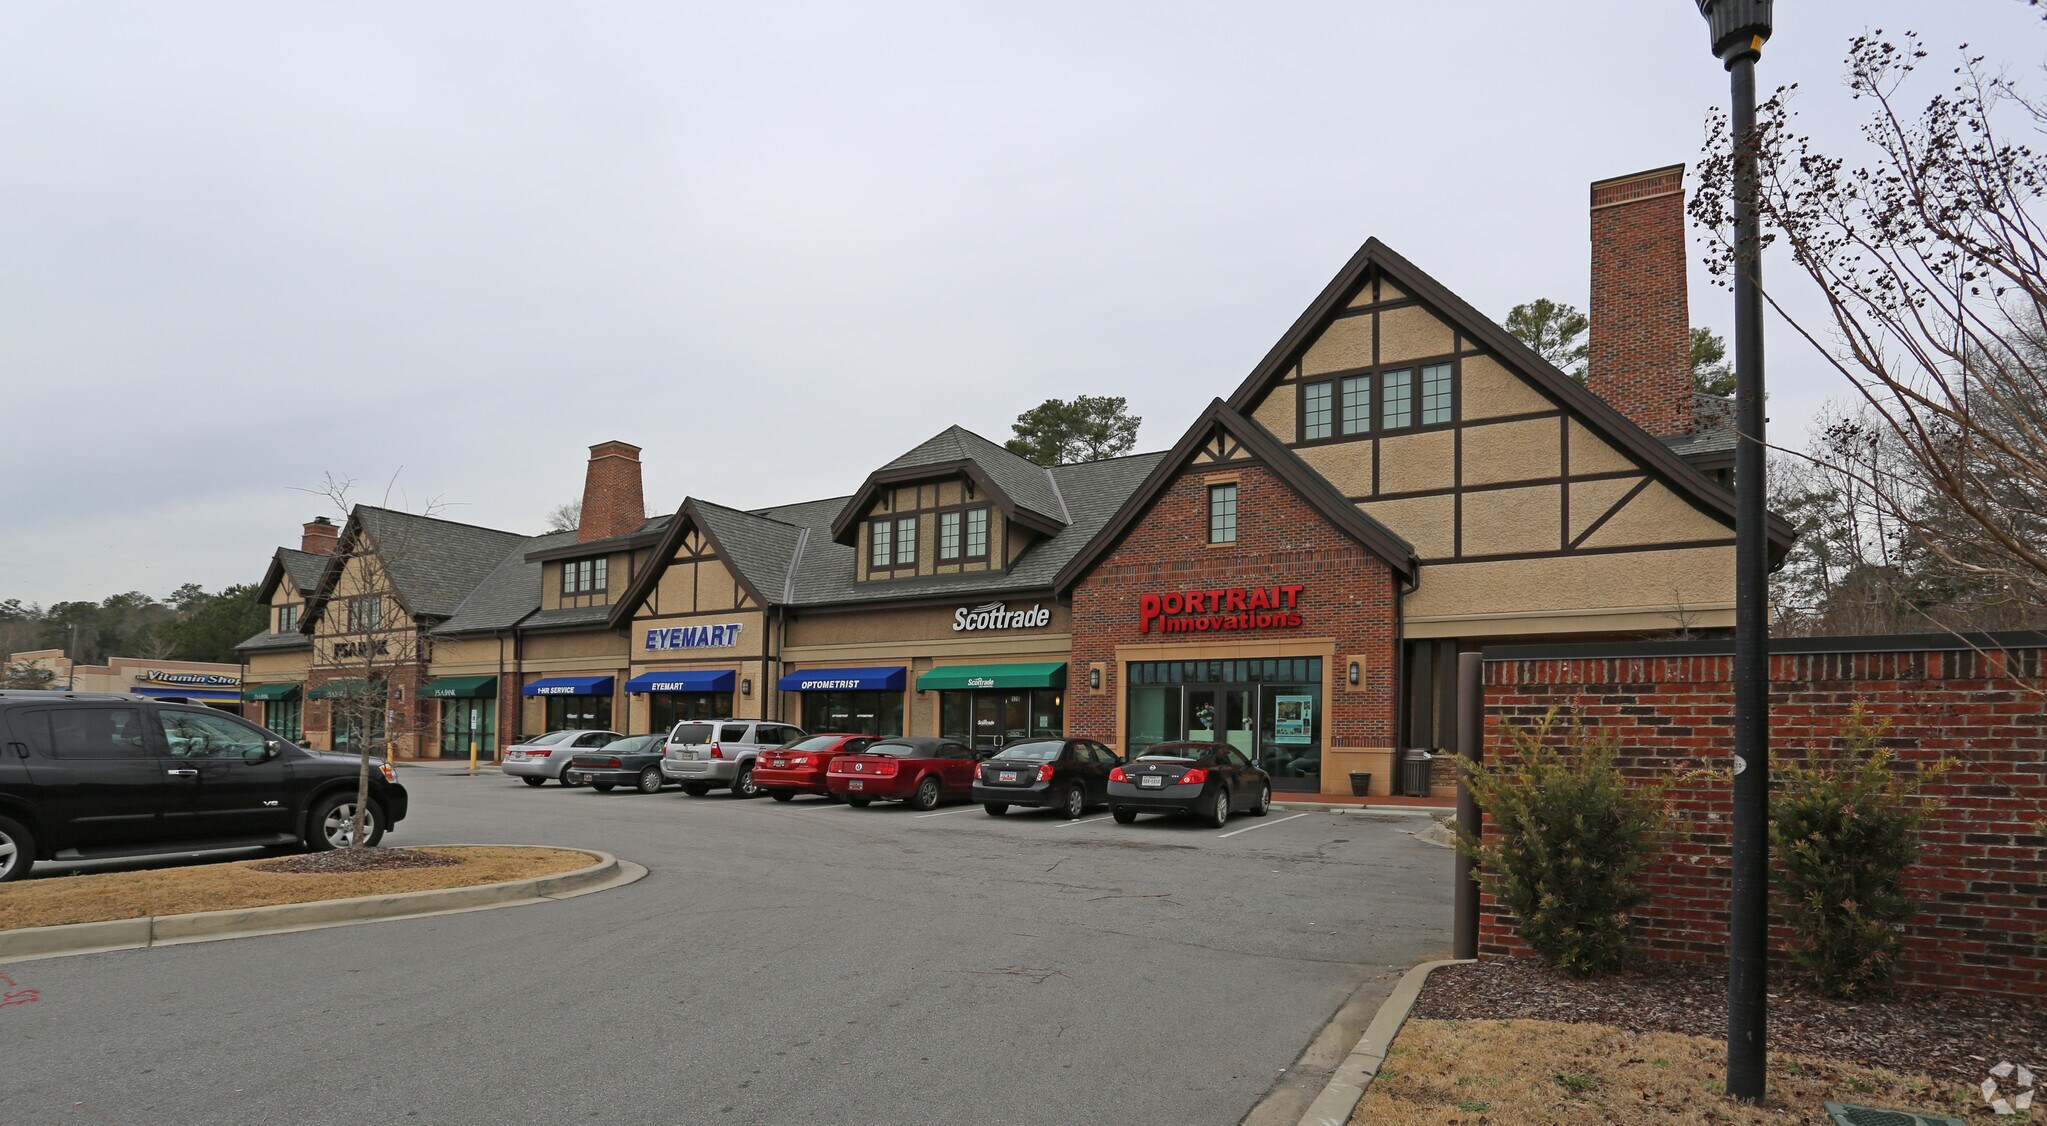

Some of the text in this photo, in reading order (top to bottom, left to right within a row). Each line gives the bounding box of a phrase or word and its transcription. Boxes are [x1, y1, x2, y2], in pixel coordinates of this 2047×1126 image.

[1140, 585, 1303, 633] PORTRAIT
[952, 603, 1050, 631] Scottrade
[1159, 610, 1303, 633] Innovations
[645, 623, 742, 651] EYEMART
[147, 670, 205, 683] Vitamin
[967, 677, 995, 687] Scottrade
[550, 686, 575, 694] SERVICE
[651, 682, 684, 691] EYEMART
[801, 680, 860, 689] OPTOMETRIST
